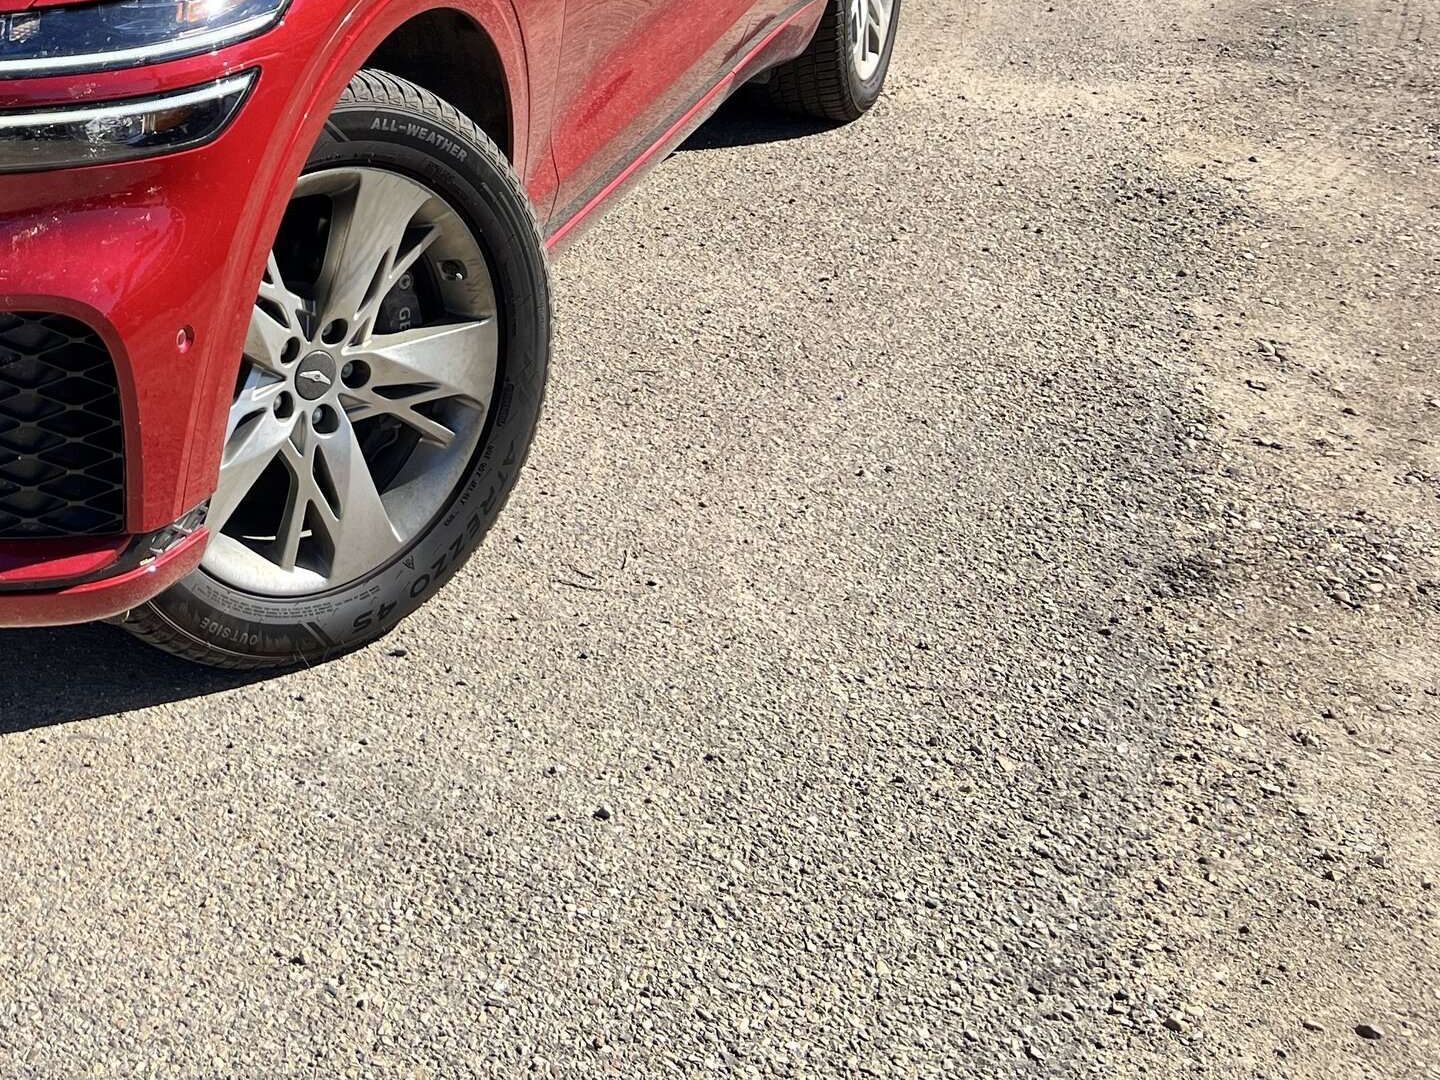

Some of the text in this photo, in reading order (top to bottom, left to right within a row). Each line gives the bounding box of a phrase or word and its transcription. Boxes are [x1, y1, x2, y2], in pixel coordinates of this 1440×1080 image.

[370, 117, 468, 162] ALL-WEATHER
[409, 439, 516, 599] ATREZZO
[200, 616, 258, 647] OUTSIDE
[352, 600, 398, 632] 4S
